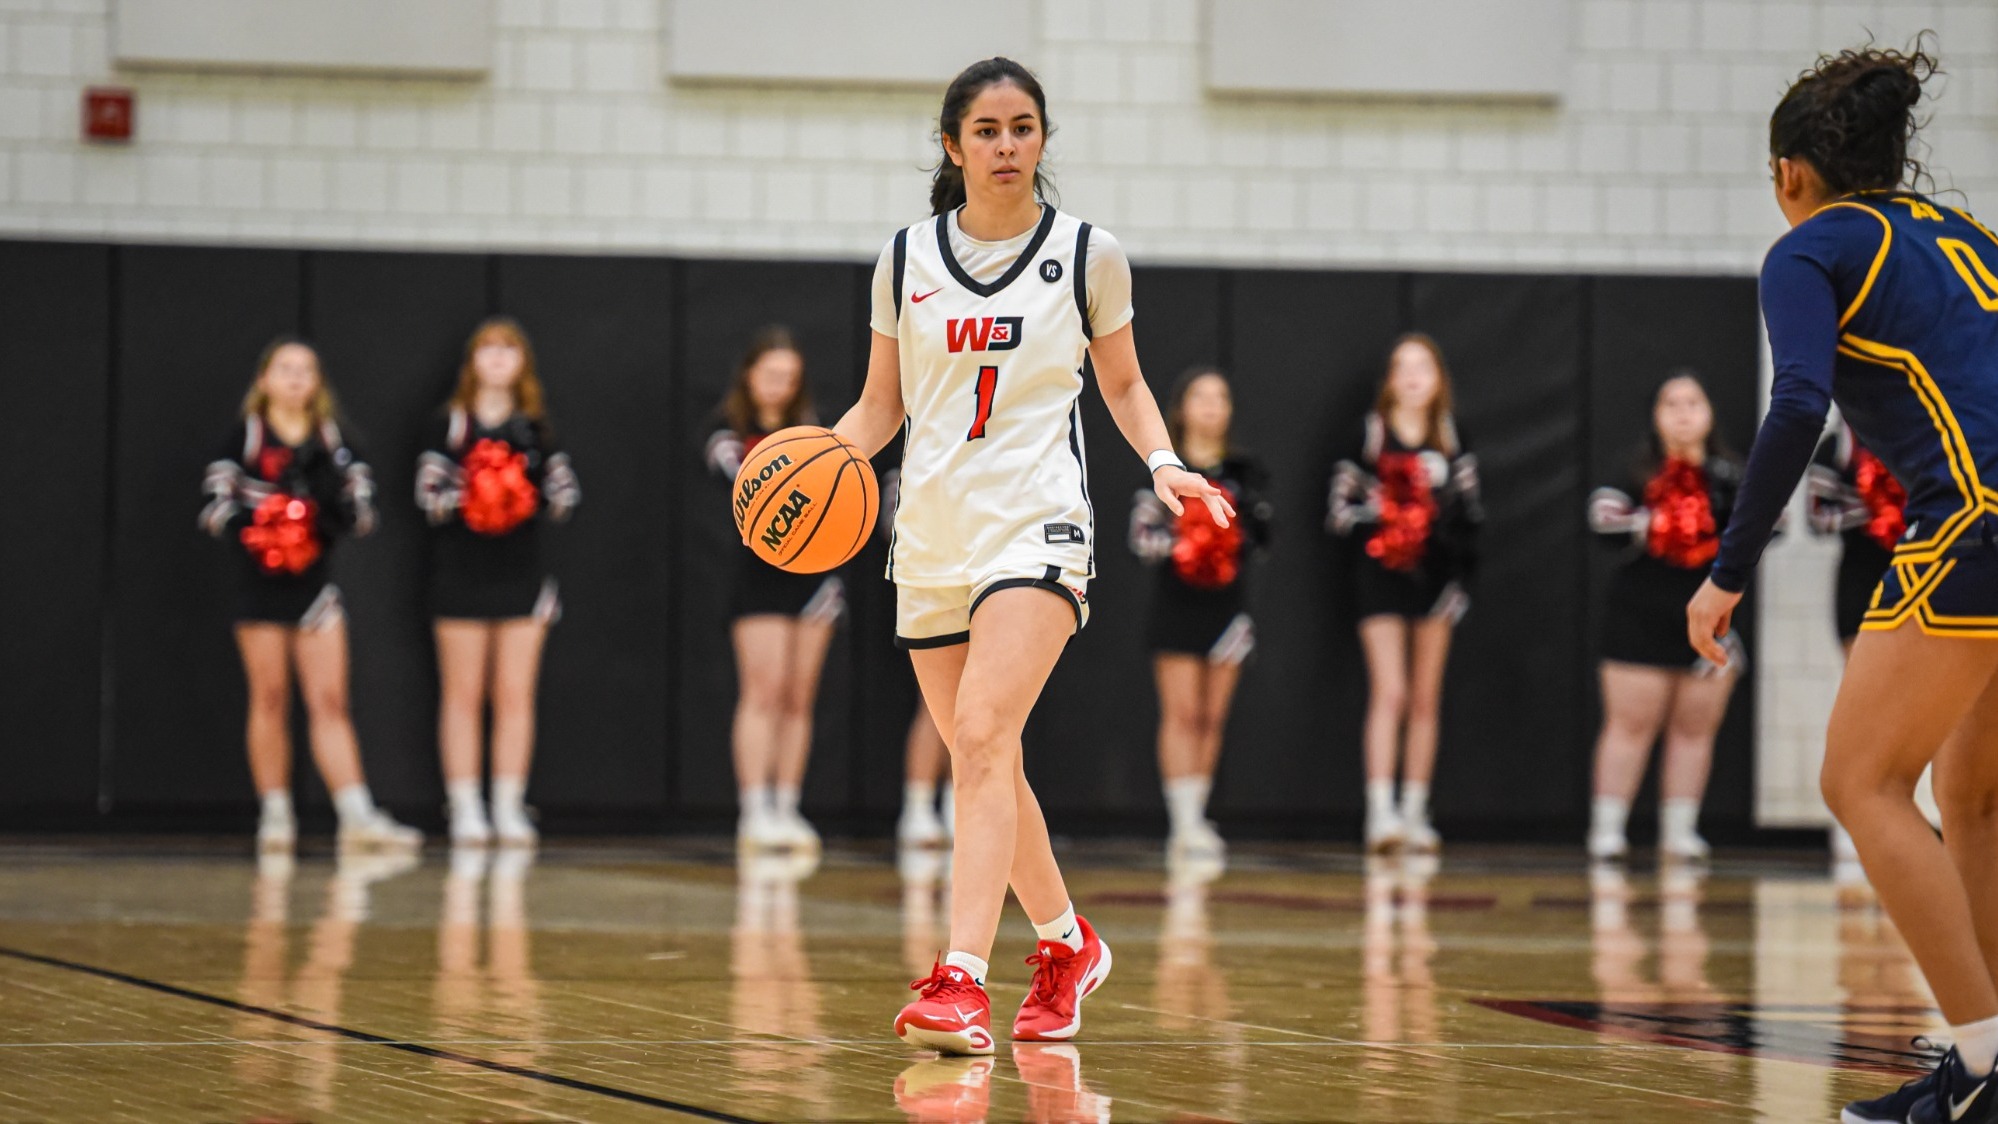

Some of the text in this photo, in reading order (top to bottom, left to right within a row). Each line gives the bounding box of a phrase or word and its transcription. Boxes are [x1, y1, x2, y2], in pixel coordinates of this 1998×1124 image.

[1046, 263, 1057, 278] VS
[947, 316, 1024, 354] W&J
[967, 365, 998, 441] 1
[734, 454, 793, 530] Wilson
[761, 489, 811, 552] NCAA
